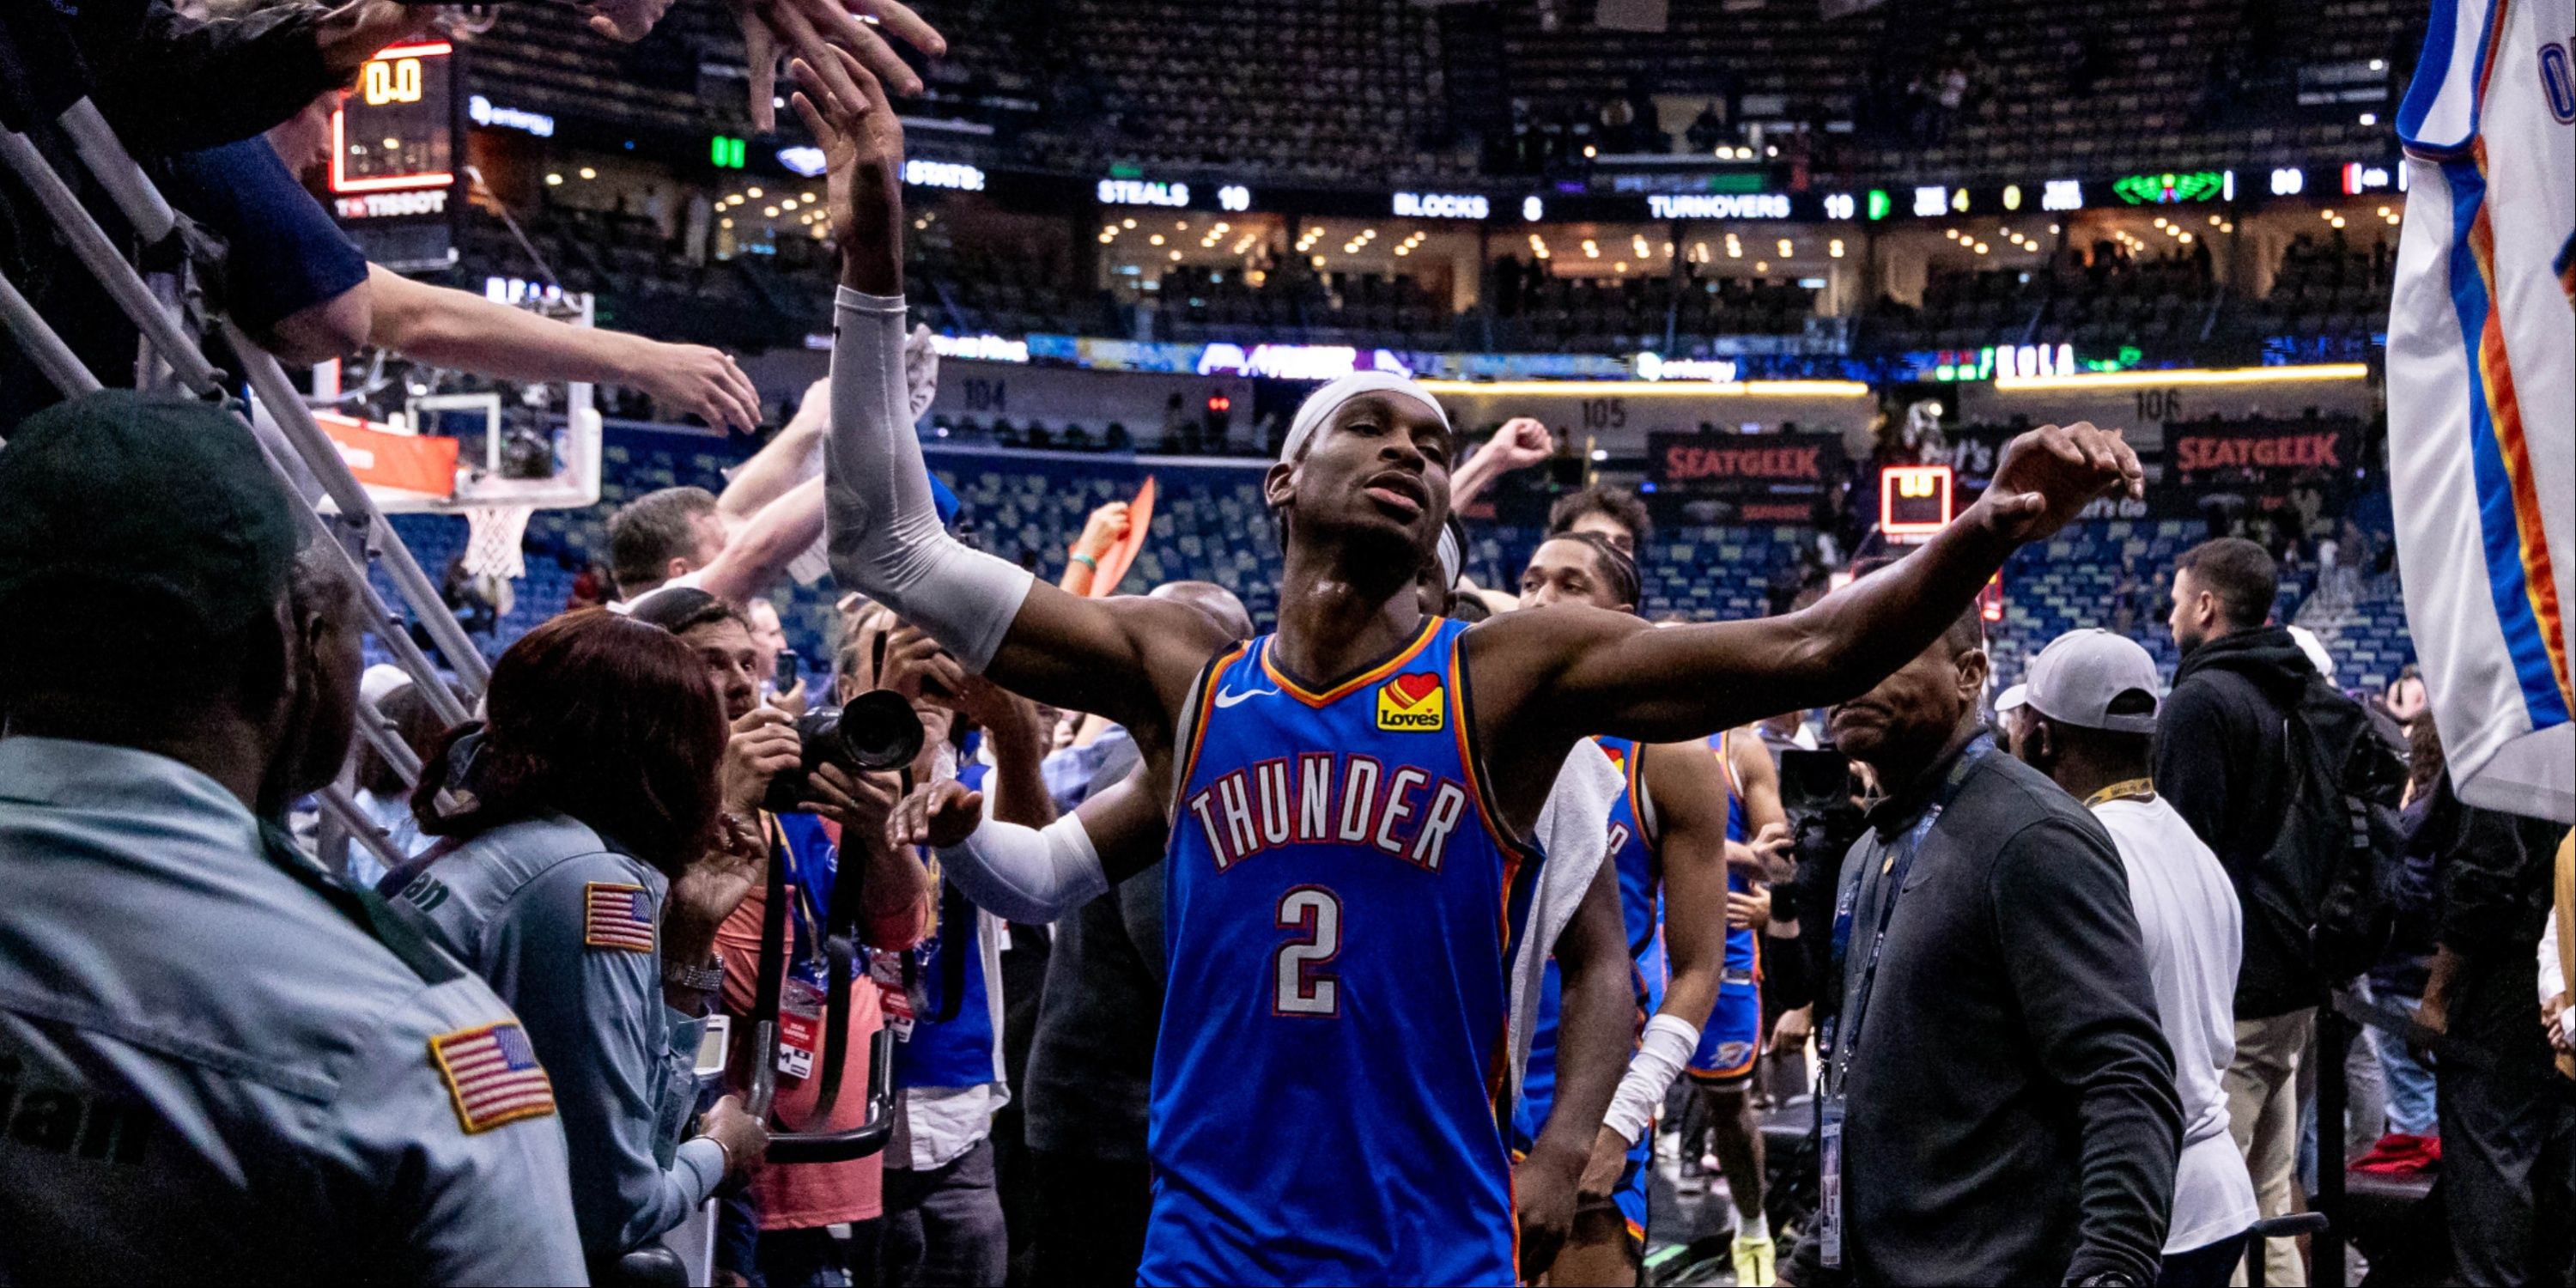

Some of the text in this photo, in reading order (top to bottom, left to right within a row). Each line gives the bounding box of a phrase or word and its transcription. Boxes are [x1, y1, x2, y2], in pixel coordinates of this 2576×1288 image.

[365, 58, 422, 106] 0.0
[905, 160, 985, 191] STATS:
[366, 190, 447, 215] TISSOT
[1098, 179, 1189, 207] STEALS
[1393, 192, 1489, 219] BLOCKS
[1647, 194, 1791, 219] TURNOVERS
[1581, 398, 1626, 428] 105
[1666, 446, 1821, 478] SEATGEEK
[2177, 432, 2340, 470] SEATGEEK
[1188, 751, 1472, 875] THUNDER
[1273, 884, 1343, 1018] 2
